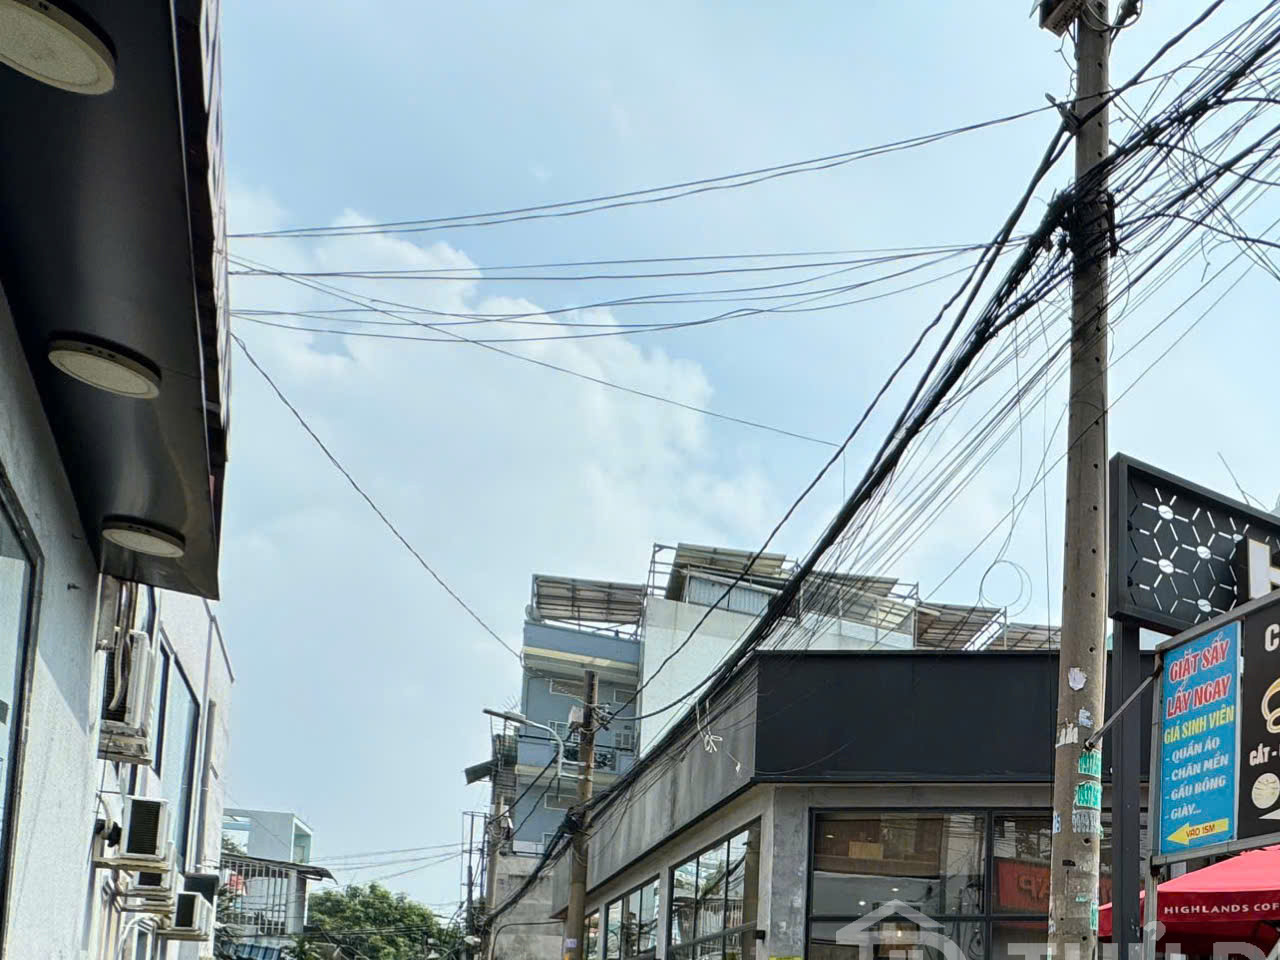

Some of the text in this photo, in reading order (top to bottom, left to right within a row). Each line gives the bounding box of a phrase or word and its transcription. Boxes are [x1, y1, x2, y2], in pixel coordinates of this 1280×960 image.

[1192, 673, 1233, 710] NGAY
[1164, 703, 1235, 744] GIÁ SINH VIÊN
[1164, 903, 1250, 915] HIGHLANDS
